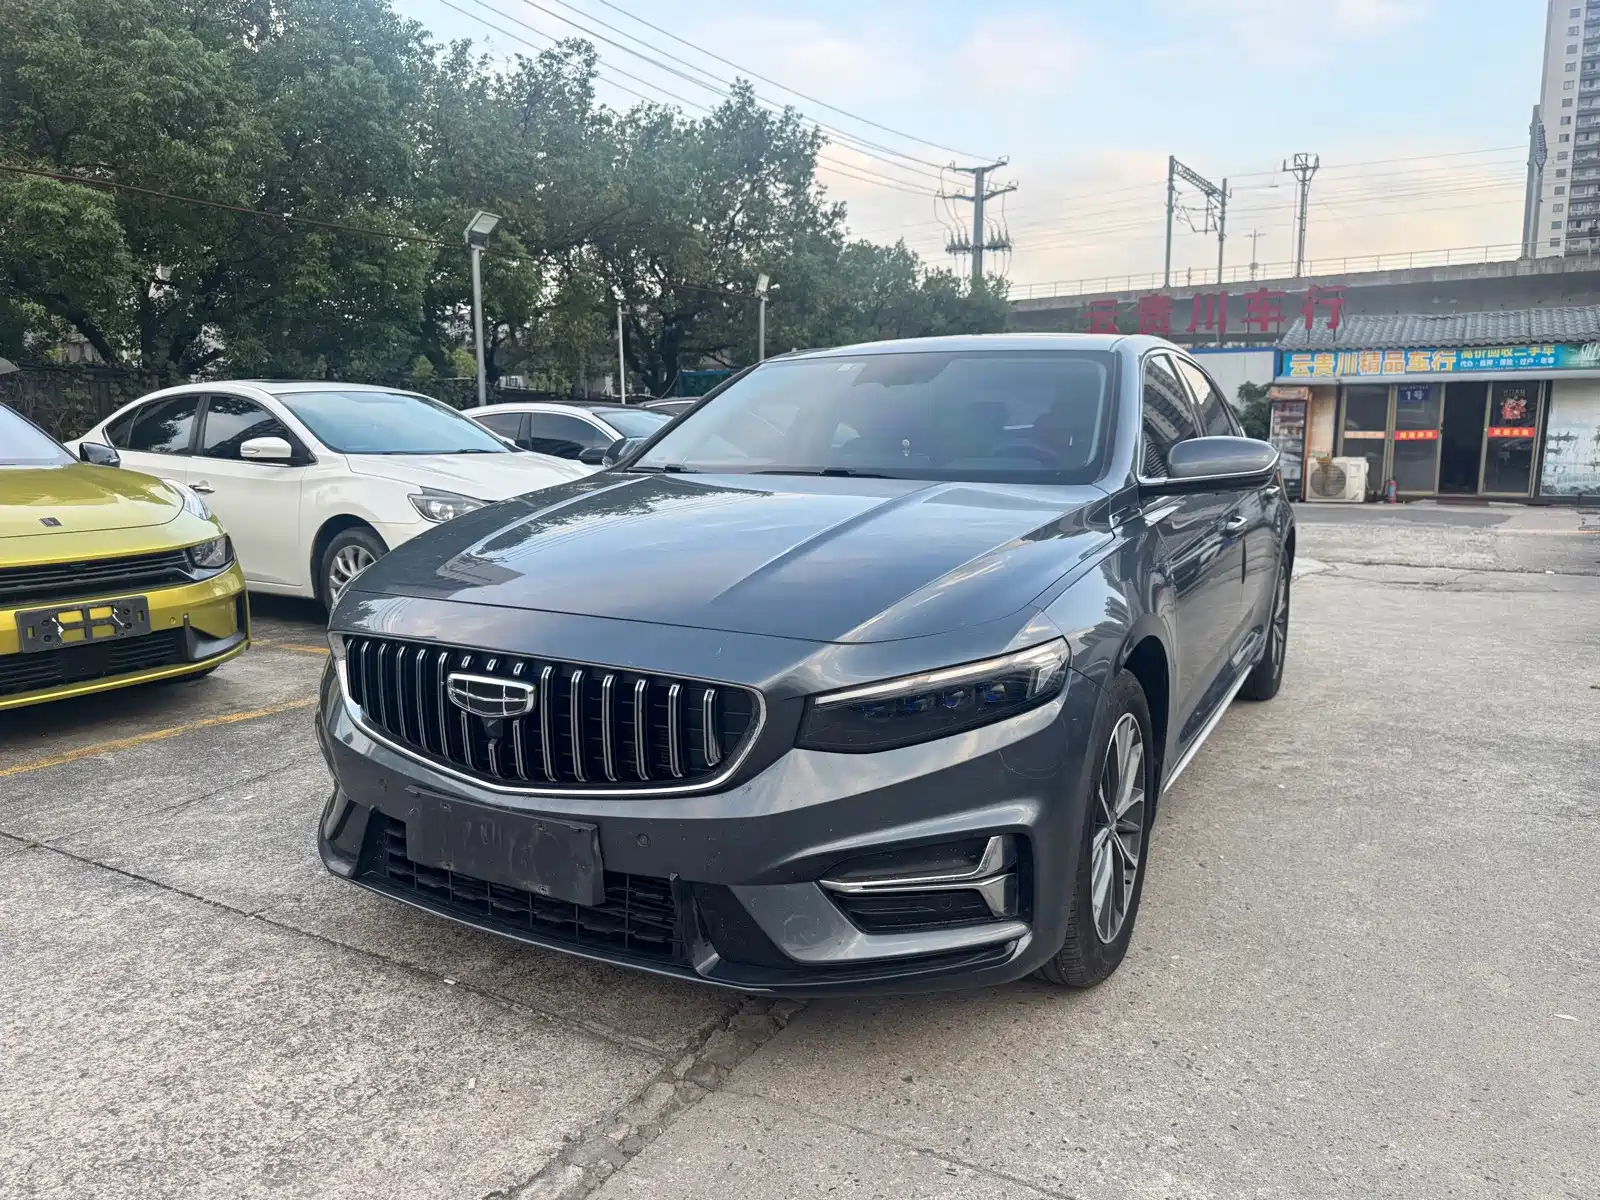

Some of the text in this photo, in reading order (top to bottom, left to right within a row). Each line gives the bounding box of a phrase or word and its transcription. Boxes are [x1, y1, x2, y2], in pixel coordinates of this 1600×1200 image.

[1083, 284, 1347, 334] 云贵川车行
[1289, 350, 1457, 377] 云贵川精品车行
[1405, 390, 1425, 400] 1号
